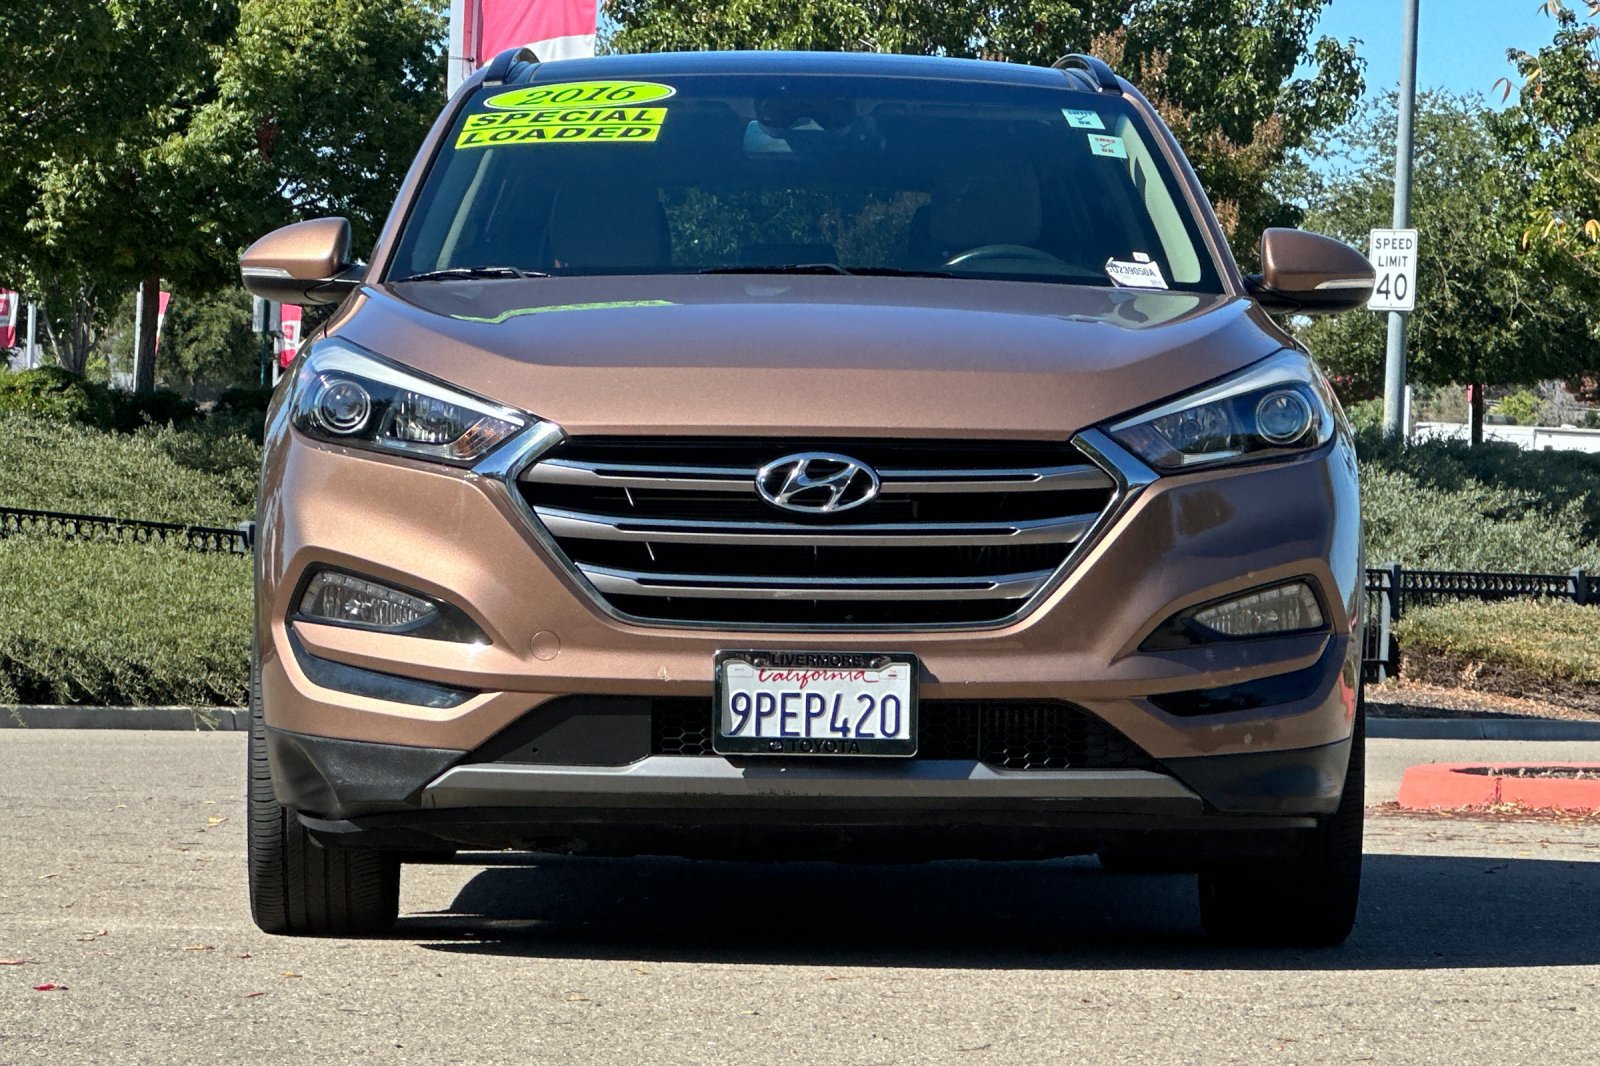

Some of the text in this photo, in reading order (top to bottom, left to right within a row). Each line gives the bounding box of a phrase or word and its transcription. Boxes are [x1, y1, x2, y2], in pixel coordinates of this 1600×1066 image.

[515, 85, 645, 106] 2016
[470, 109, 655, 127] SPECIAL
[460, 126, 653, 145] LOADED
[1375, 238, 1413, 250] SPEED
[1378, 255, 1408, 268] LIMIT
[1376, 273, 1408, 301] 40
[772, 653, 863, 666] LIVERMORE
[758, 669, 879, 689] California
[729, 692, 901, 737] 9PEP420
[787, 740, 861, 753] TOYOTA
